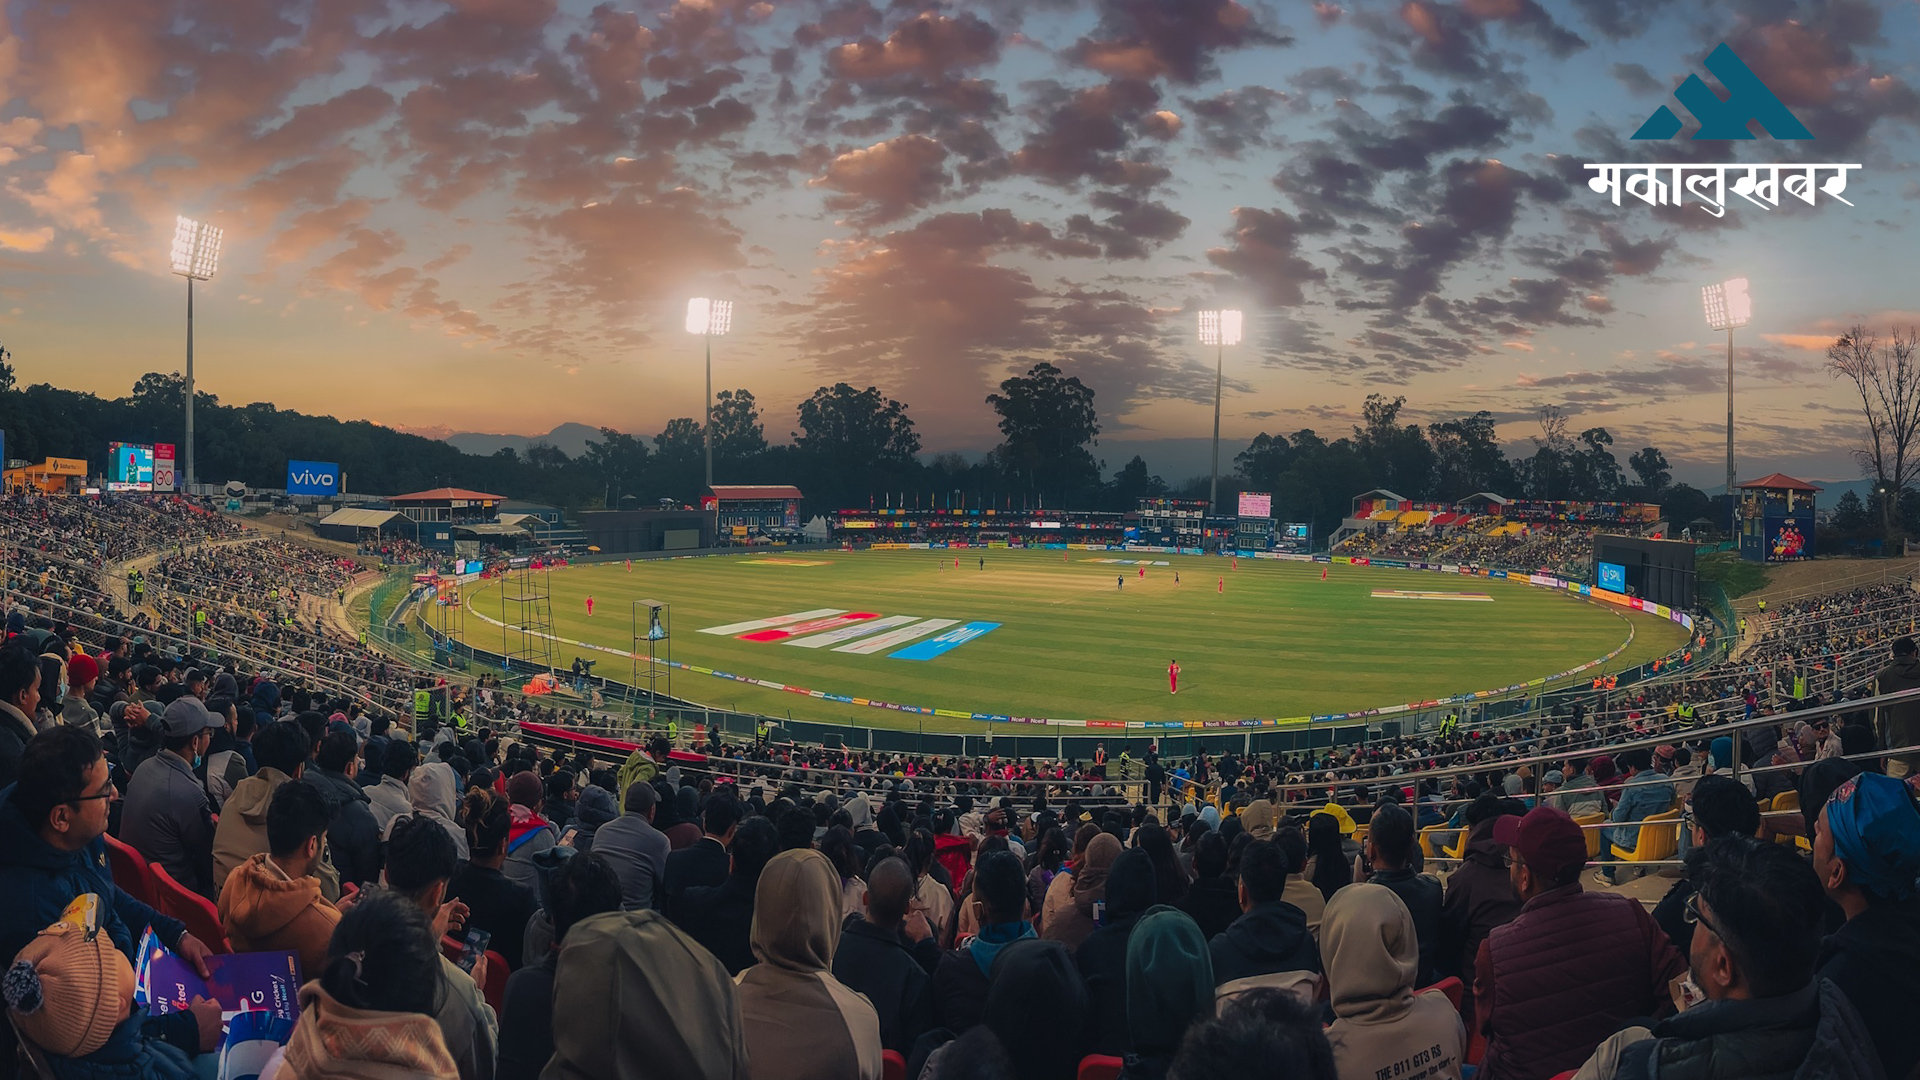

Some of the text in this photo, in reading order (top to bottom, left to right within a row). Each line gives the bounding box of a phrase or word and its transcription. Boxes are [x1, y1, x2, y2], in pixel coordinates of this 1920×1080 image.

[155, 470, 173, 486] GO
[291, 469, 333, 486] vivo
[272, 981, 282, 1008] Cricket
[1375, 1066, 1392, 1080] THE
[1412, 1050, 1430, 1068] GT3
[1431, 1044, 1442, 1059] RS
